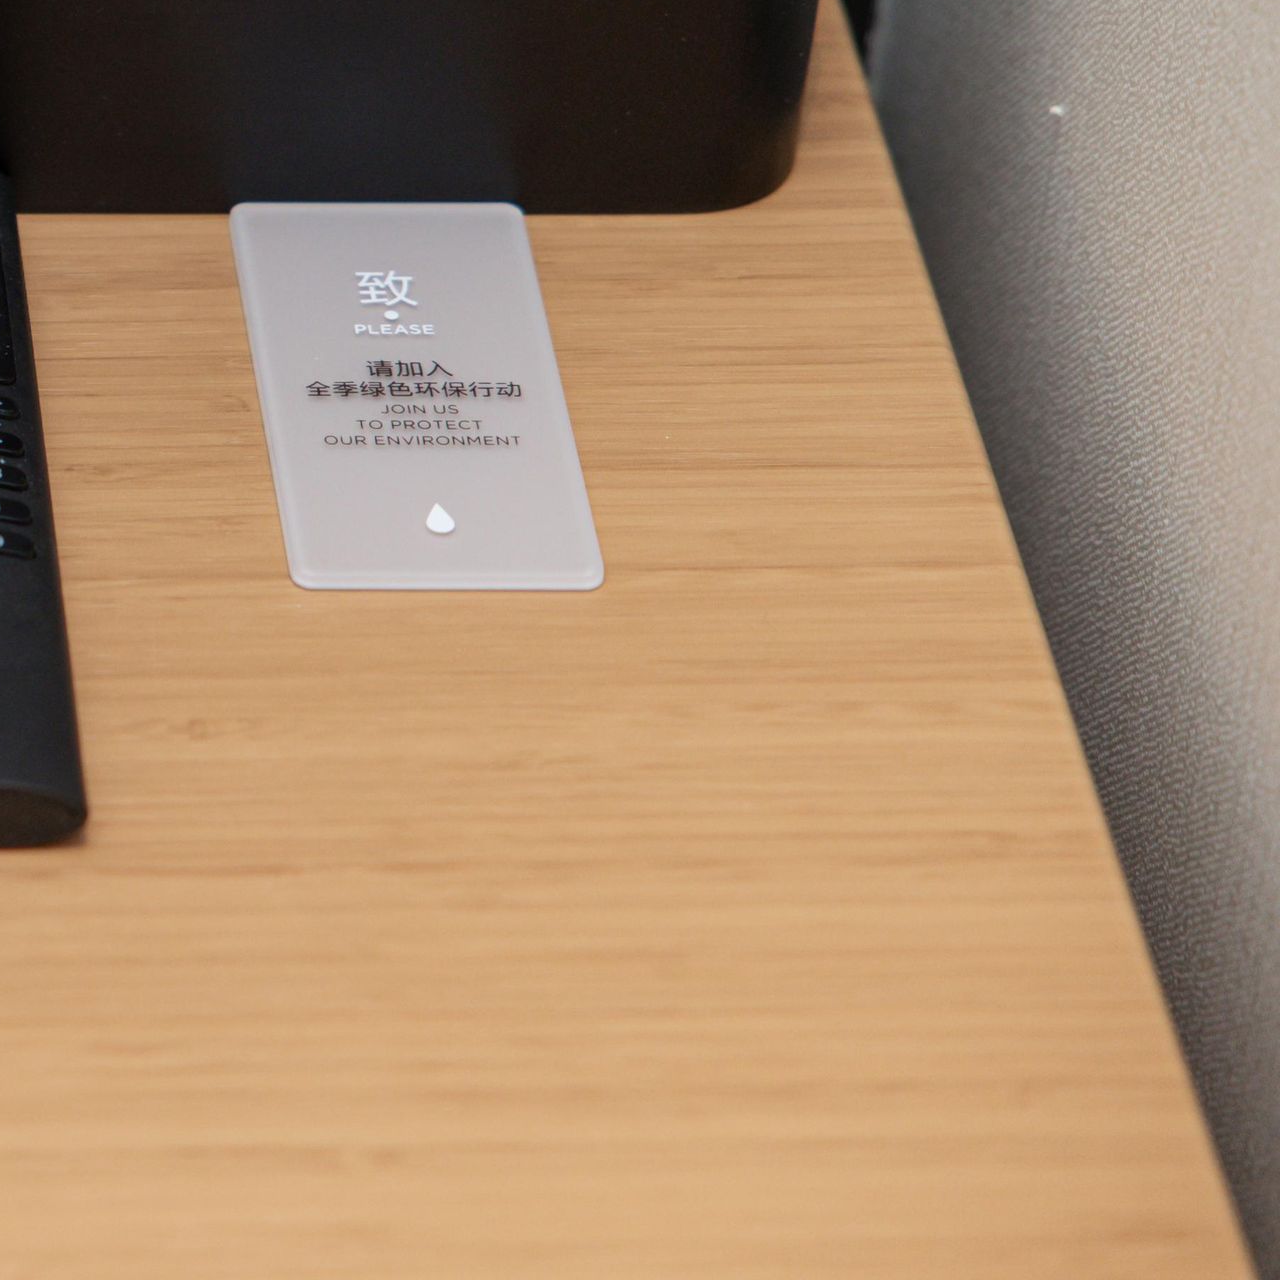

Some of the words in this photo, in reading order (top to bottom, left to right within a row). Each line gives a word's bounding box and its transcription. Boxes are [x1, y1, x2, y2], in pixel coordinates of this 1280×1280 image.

[355, 270, 419, 306] 致
[354, 323, 435, 335] PLEASE
[366, 360, 453, 378] 请加入
[306, 381, 522, 398] 全季绿色环保行动
[382, 404, 427, 415] JOIN
[433, 404, 459, 415] US
[356, 419, 384, 430] TO
[391, 419, 482, 430] PROTECT
[324, 435, 367, 446] OUR
[374, 435, 520, 446] ENVIRONMENT
